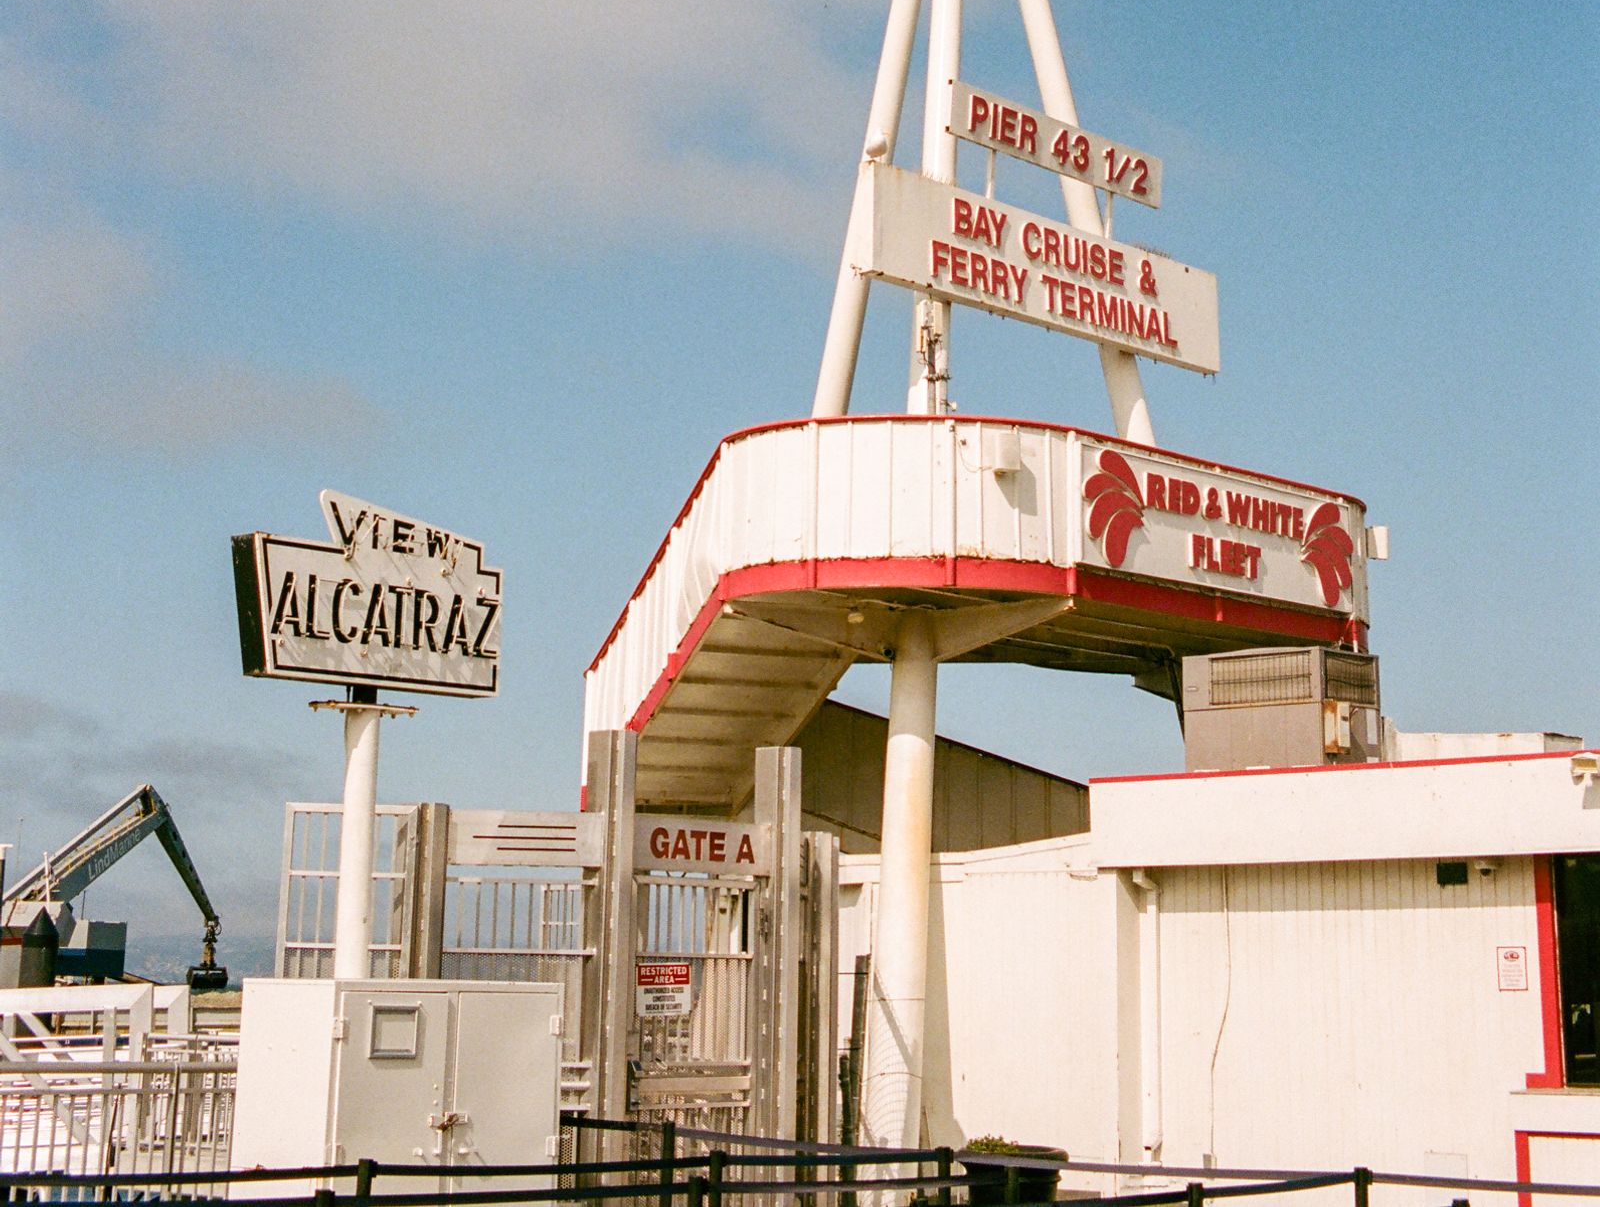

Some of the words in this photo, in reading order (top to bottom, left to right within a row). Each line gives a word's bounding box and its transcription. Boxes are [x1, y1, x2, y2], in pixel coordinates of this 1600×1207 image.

[968, 94, 1038, 154] PIER
[1051, 129, 1090, 173] 43
[1102, 147, 1150, 195] 1/2
[952, 197, 1008, 247] BAY
[1022, 220, 1126, 286] CRUISE
[1139, 259, 1158, 297] &
[930, 239, 1028, 305] FERRY
[1040, 274, 1178, 349] TERMINAL
[330, 500, 463, 563] VIEW
[1144, 472, 1200, 516] RED
[1202, 487, 1222, 520] &
[1224, 490, 1304, 541] WHITE
[1189, 533, 1261, 580] FLEET
[271, 571, 501, 659] ALCATRAZ
[650, 826, 726, 862] GATE
[736, 833, 755, 864] A
[641, 966, 687, 975] RESTRICTED
[654, 975, 675, 984] AREA
